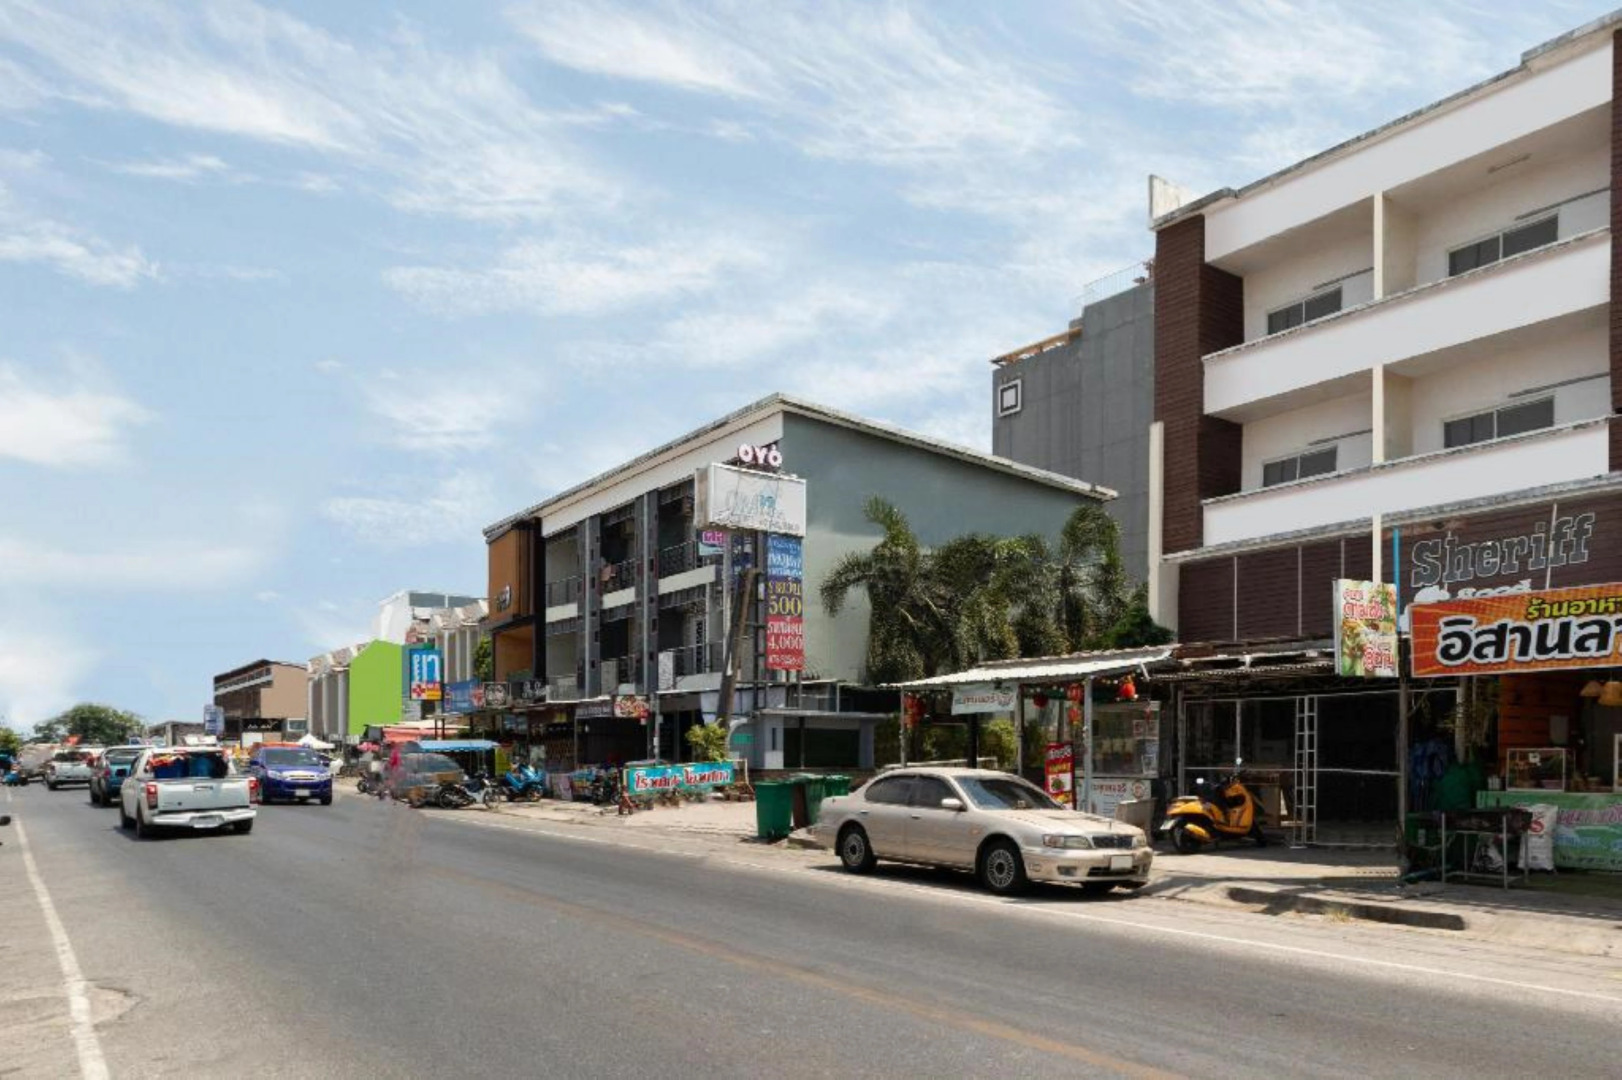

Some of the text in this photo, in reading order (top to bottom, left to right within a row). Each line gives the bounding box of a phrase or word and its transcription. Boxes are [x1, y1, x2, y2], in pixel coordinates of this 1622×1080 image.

[1411, 512, 1595, 587] Sheriff
[769, 595, 803, 616] 500
[1437, 616, 1622, 666] อิสานล
